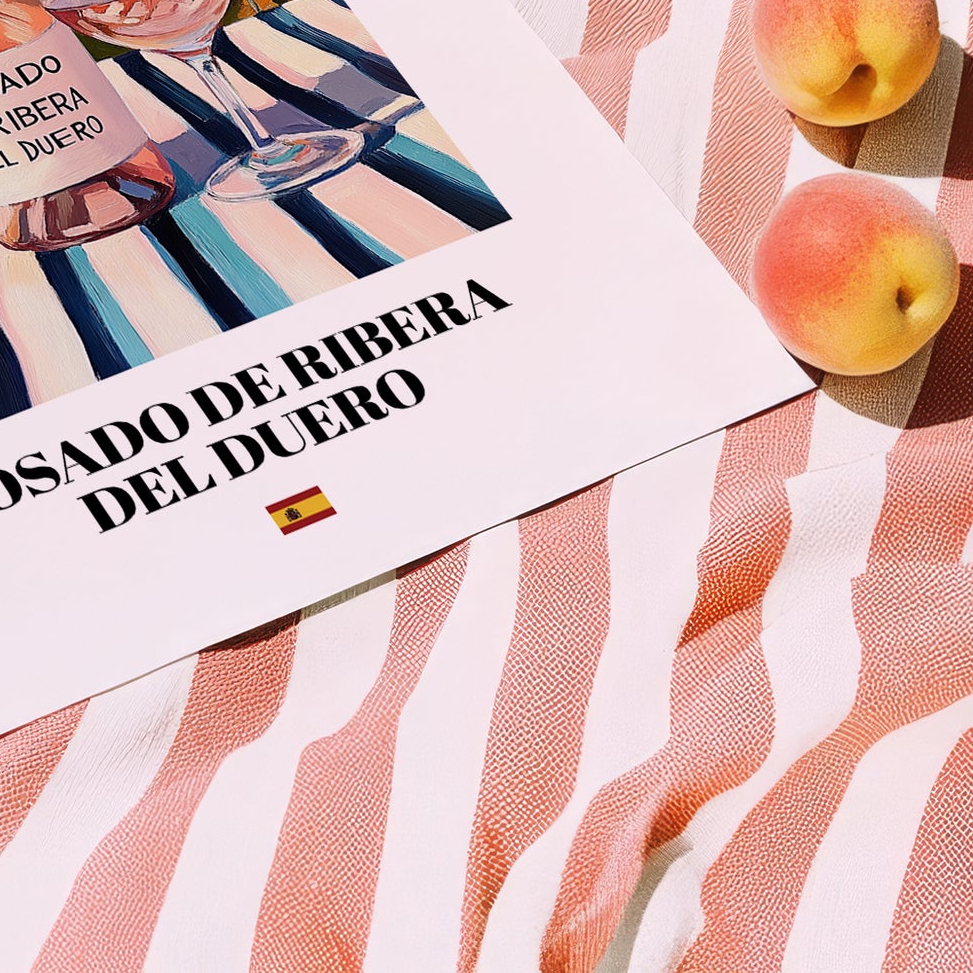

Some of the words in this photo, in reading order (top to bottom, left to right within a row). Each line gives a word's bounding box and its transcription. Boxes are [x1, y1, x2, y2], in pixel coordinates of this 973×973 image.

[17, 115, 104, 163] DUERO
[185, 363, 288, 428] DE
[276, 278, 513, 392] RIBERA
[77, 455, 217, 534] DEL
[206, 368, 426, 481] DUERO
